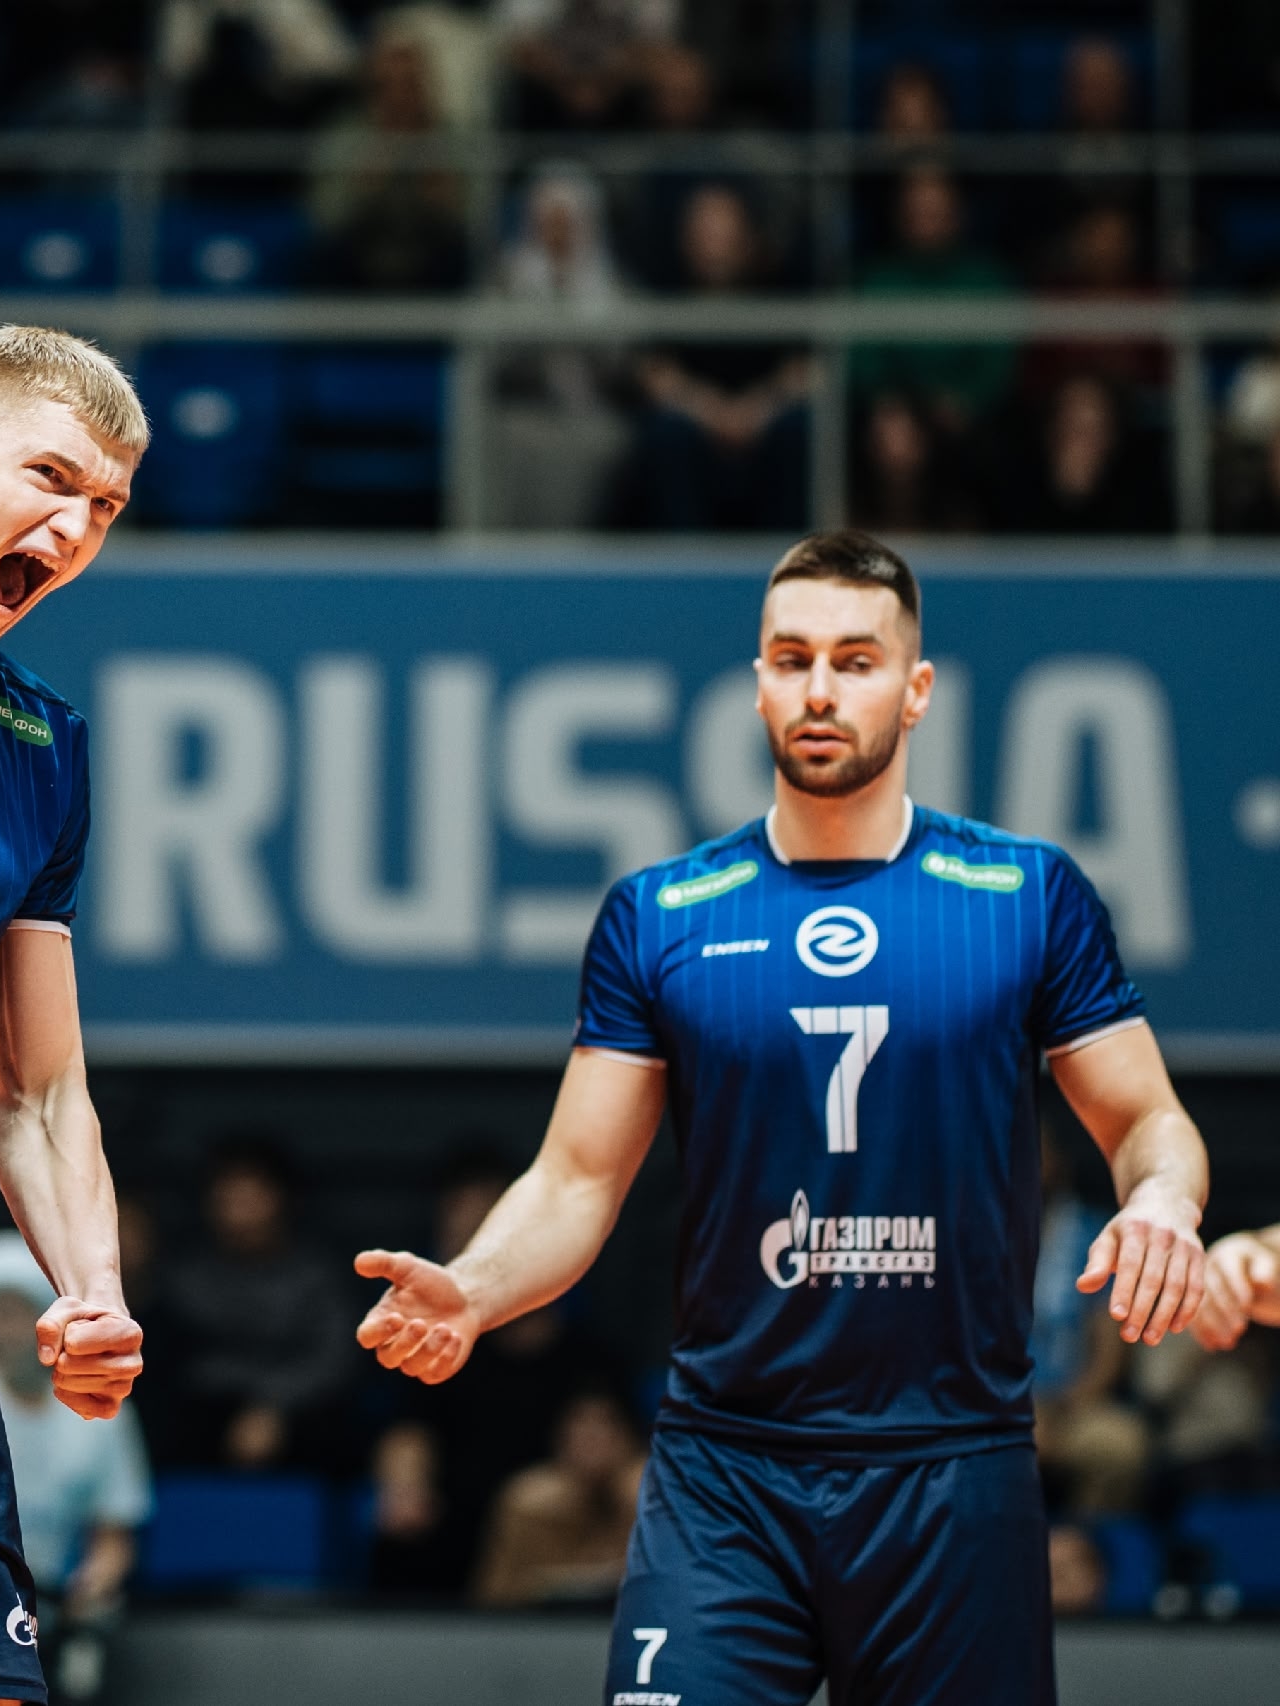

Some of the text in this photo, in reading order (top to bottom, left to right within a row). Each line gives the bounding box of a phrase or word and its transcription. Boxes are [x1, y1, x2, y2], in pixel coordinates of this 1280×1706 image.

[94, 648, 1192, 970] RUSA
[701, 938, 770, 958] ENSEN
[790, 1005, 890, 1153] 7
[808, 1215, 937, 1251] ГАЗПРОМ
[814, 1254, 933, 1269] ТРАНСГАЗ
[807, 1273, 936, 1290] КАЗАНЬ
[632, 1627, 668, 1685] 7
